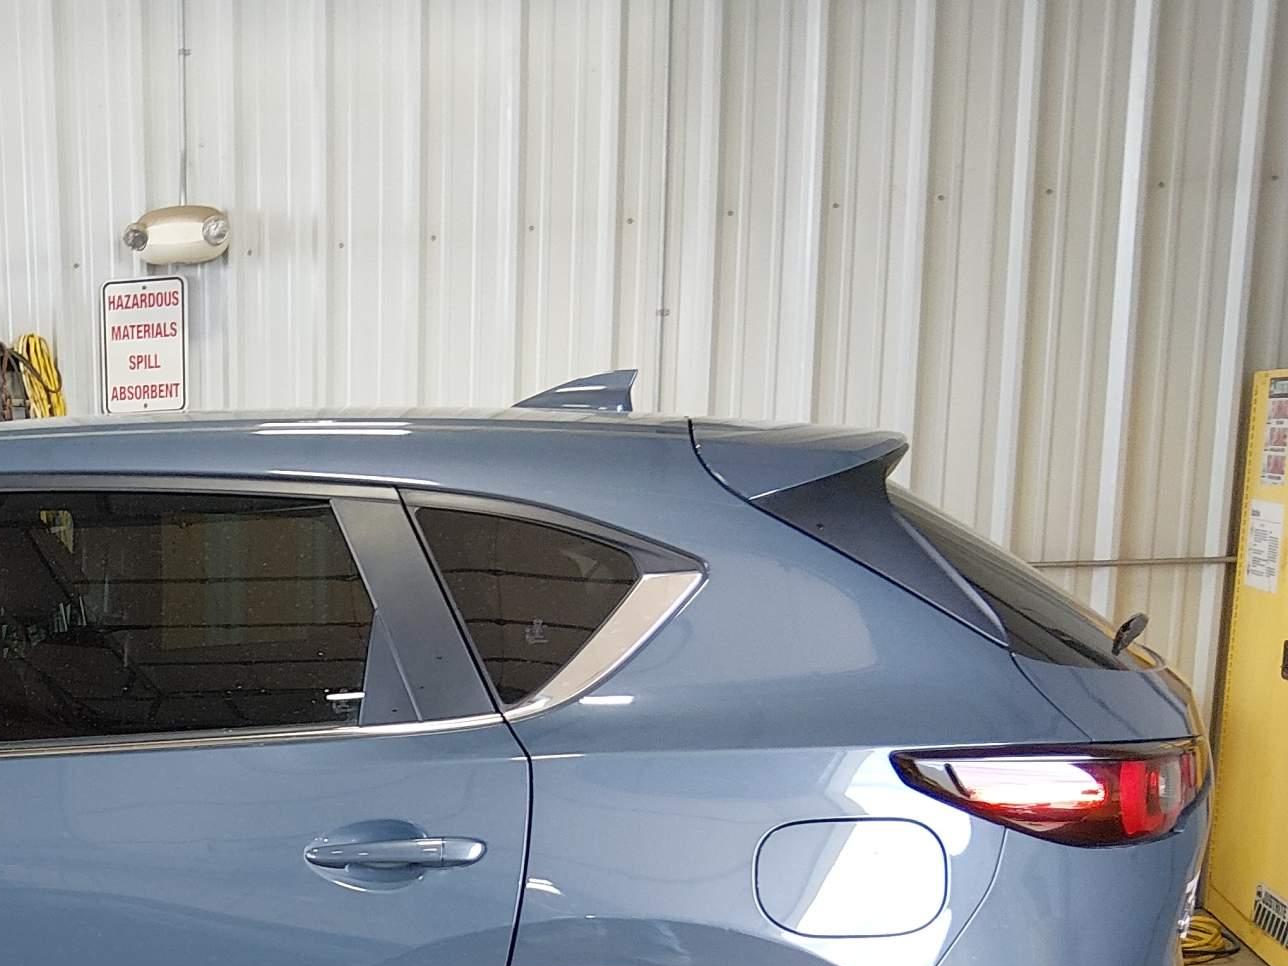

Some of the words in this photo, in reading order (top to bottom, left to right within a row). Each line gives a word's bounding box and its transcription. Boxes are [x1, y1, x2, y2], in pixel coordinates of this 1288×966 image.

[108, 290, 180, 311] HAZARDOUS
[111, 321, 178, 341] MATERIALS
[128, 354, 161, 371] SPILL
[111, 383, 180, 401] ABSORBENT
